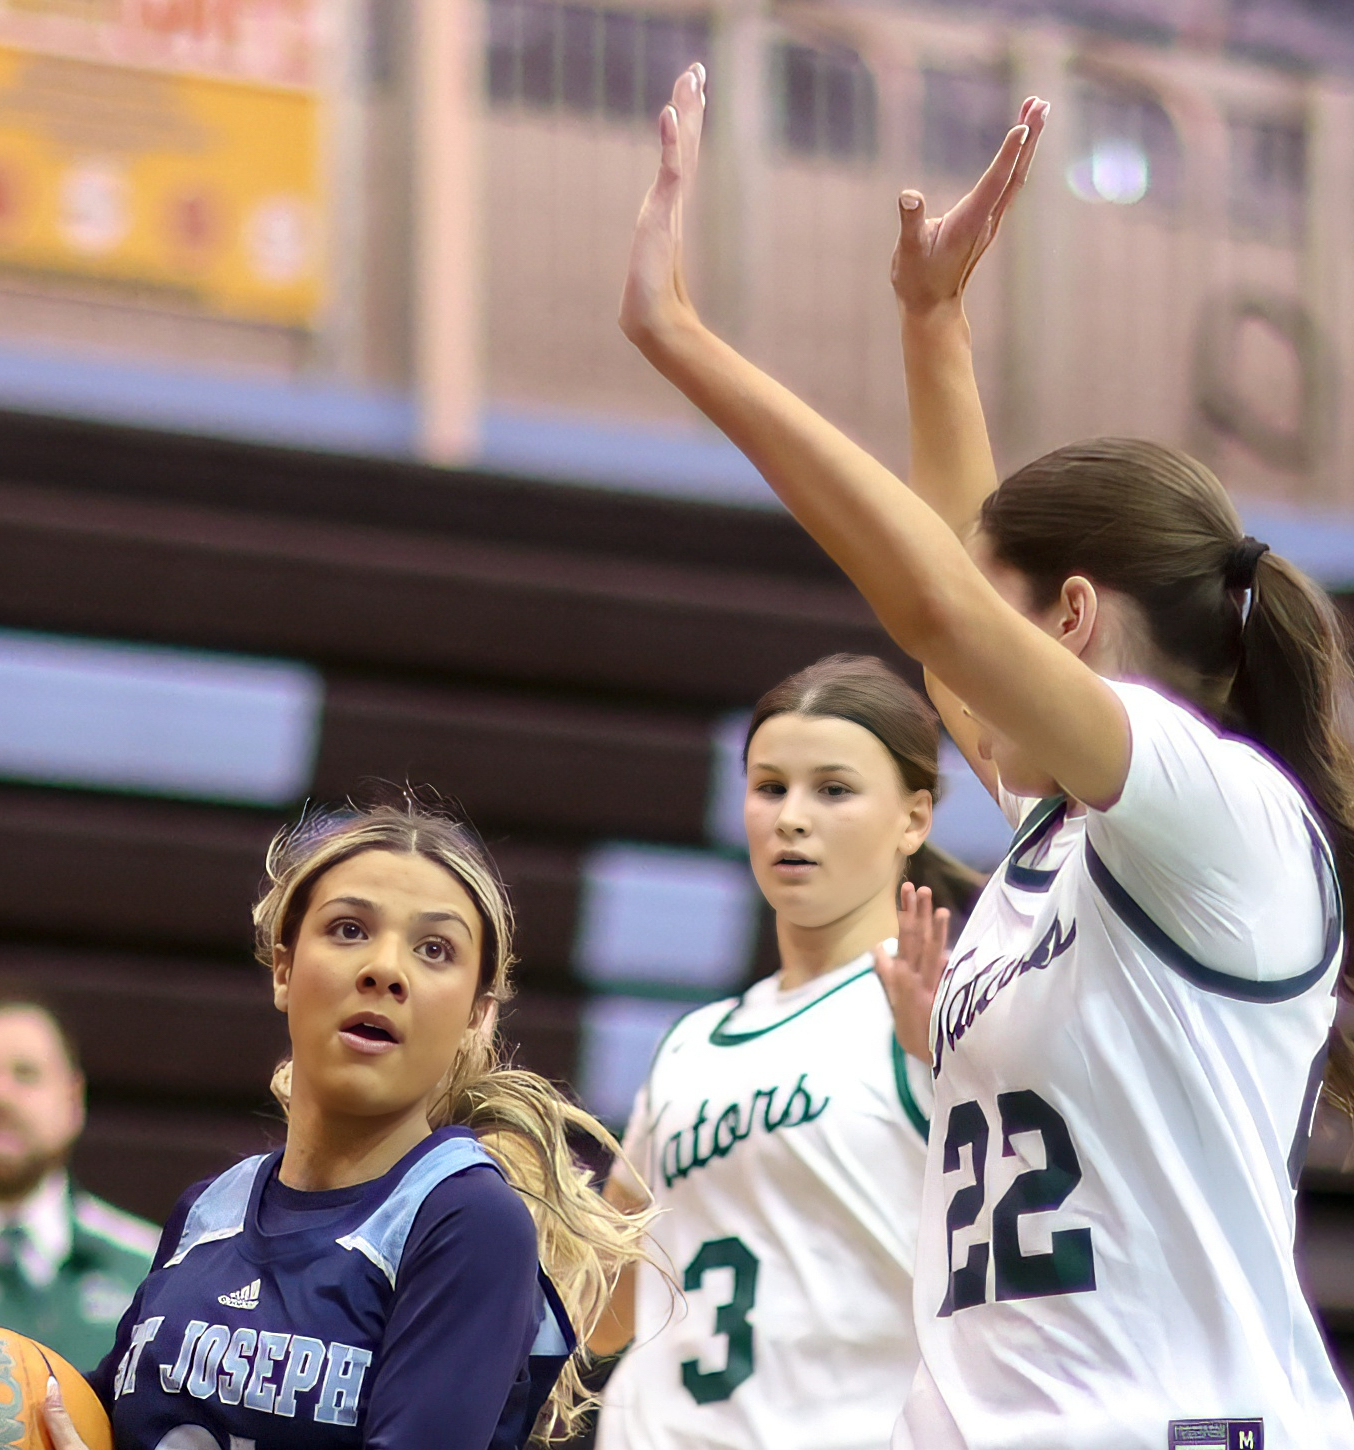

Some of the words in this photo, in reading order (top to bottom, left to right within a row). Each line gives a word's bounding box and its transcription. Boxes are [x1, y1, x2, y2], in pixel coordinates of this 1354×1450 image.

[648, 1072, 831, 1189] ators
[937, 1088, 1097, 1318] 22
[159, 1320, 373, 1427] JOSEPH
[679, 1235, 760, 1405] 3
[1238, 1430, 1255, 1450] M
